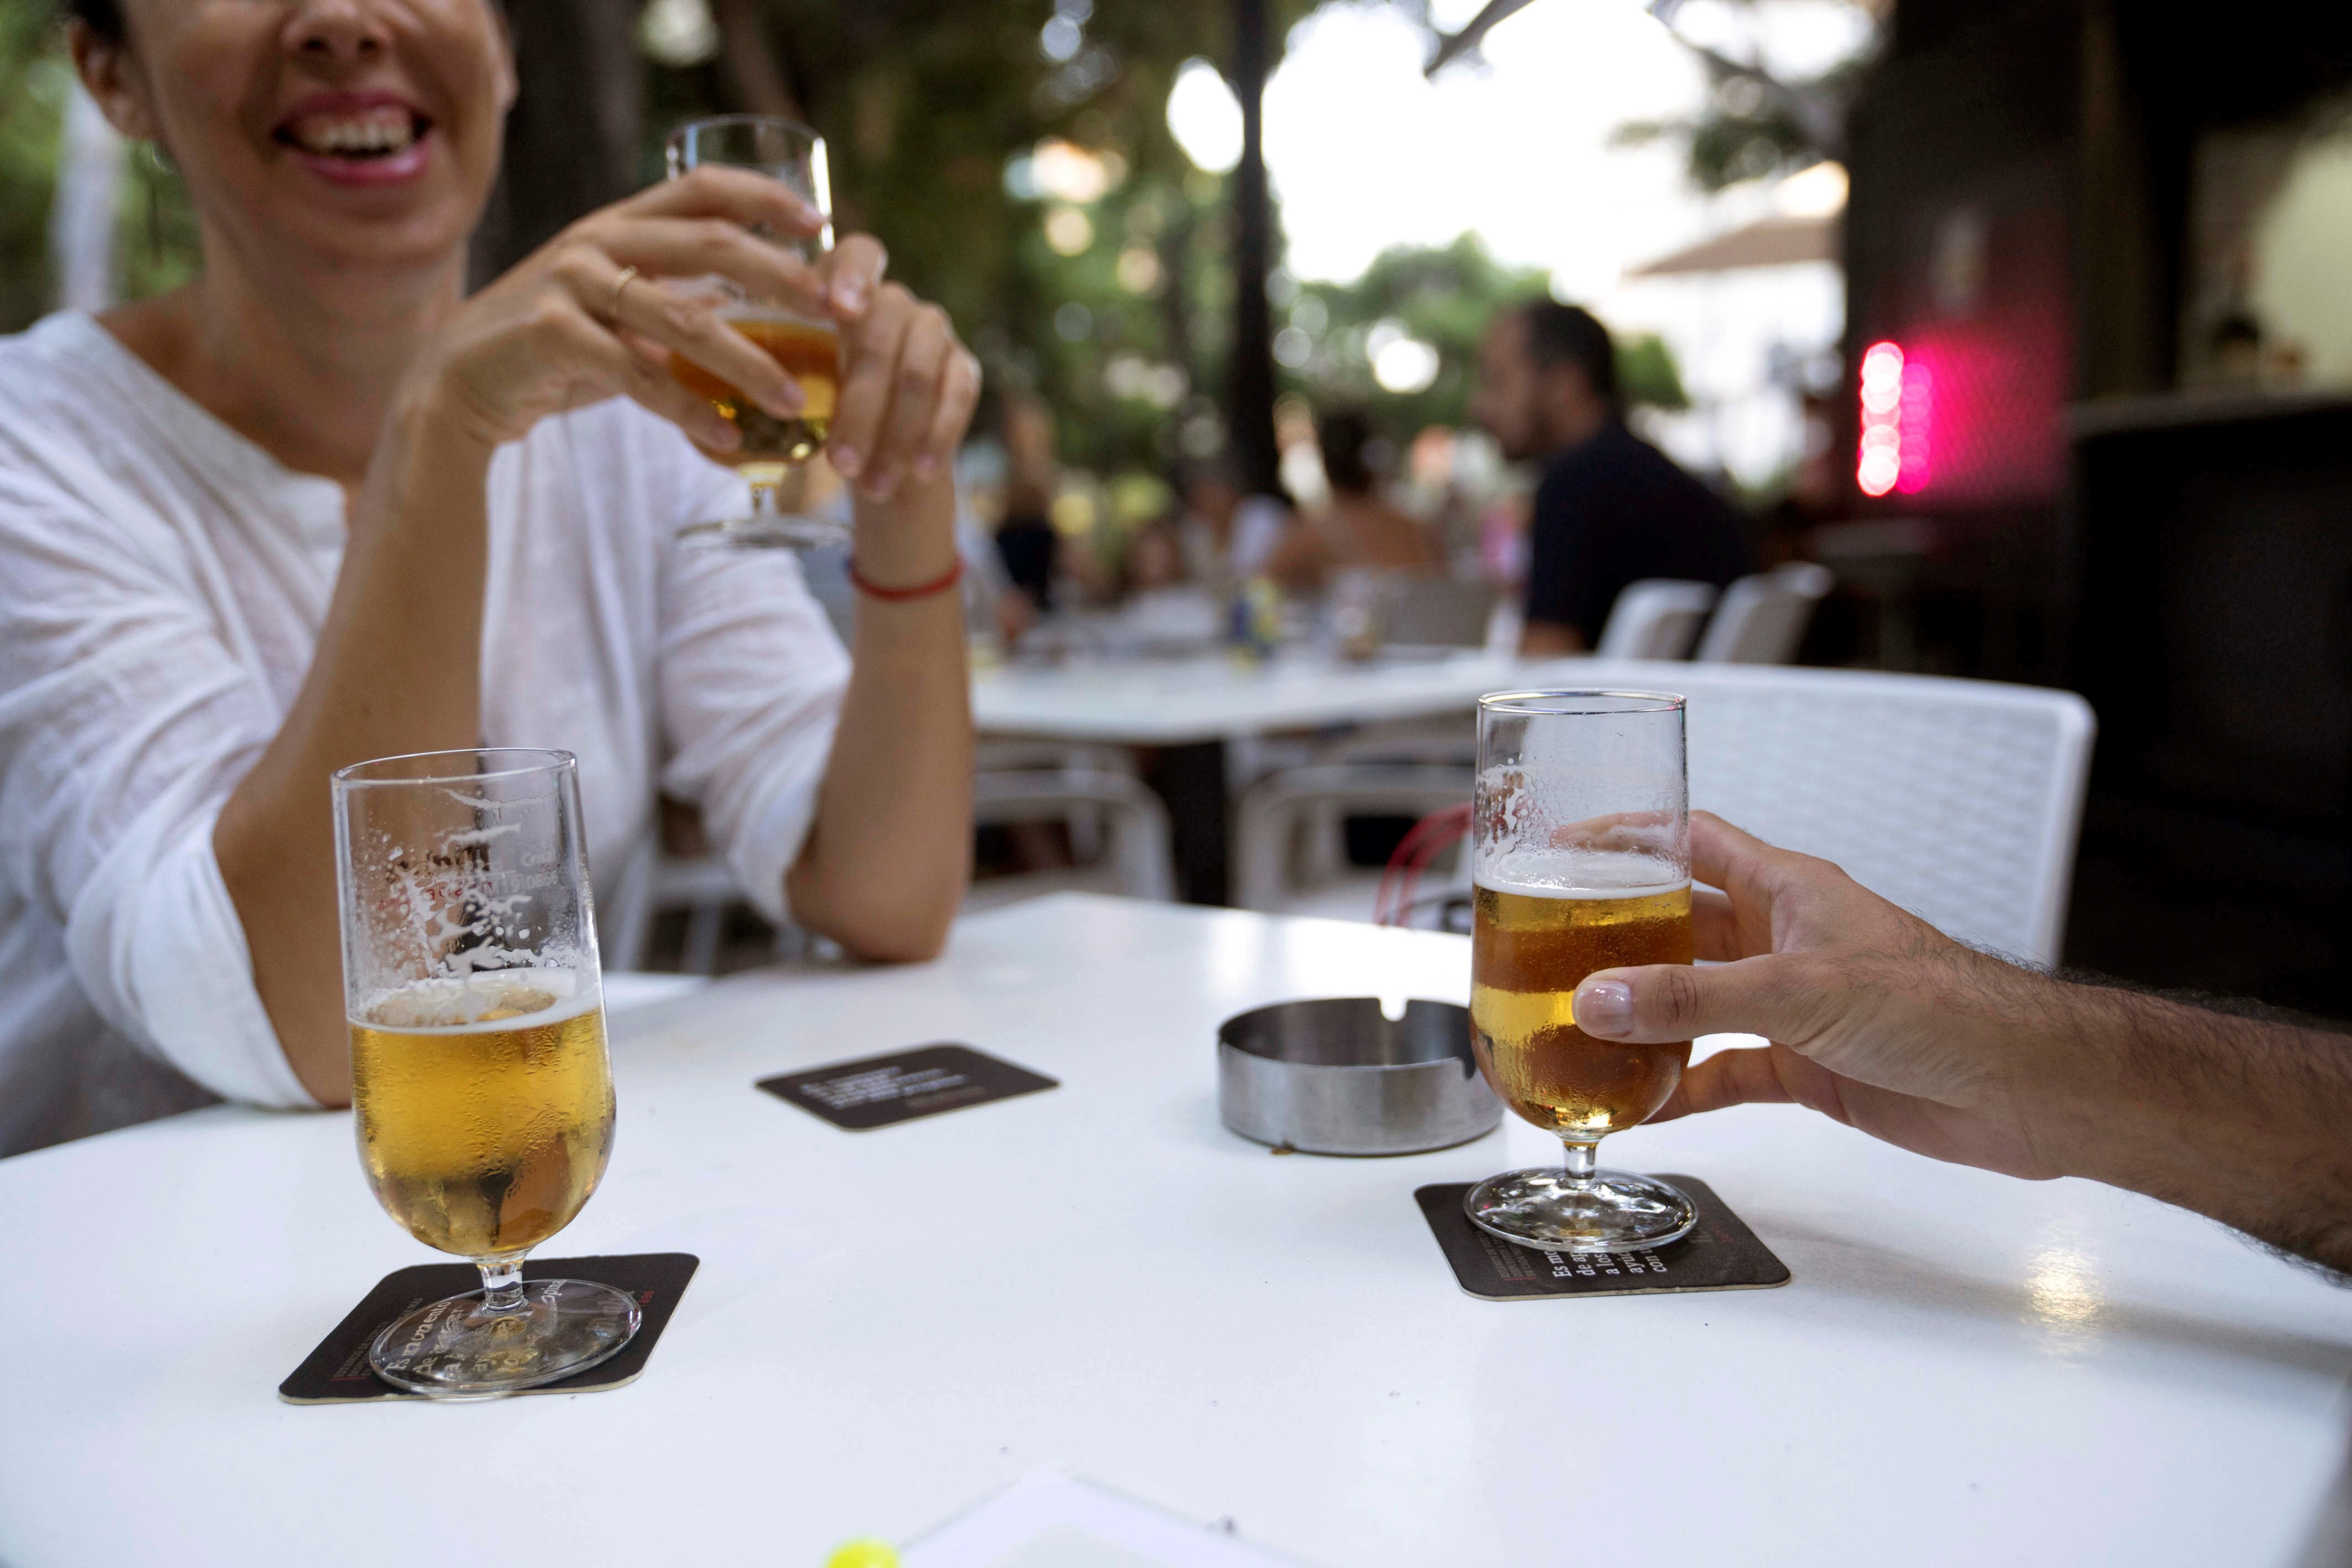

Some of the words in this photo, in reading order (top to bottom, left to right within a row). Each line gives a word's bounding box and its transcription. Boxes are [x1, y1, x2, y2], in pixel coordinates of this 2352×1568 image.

[1594, 1253, 1615, 1266] los
[1645, 1255, 1668, 1272] con
[1552, 1265, 1572, 1277] Es
[1576, 1264, 1596, 1275] de
[385, 1358, 411, 1371] Es
